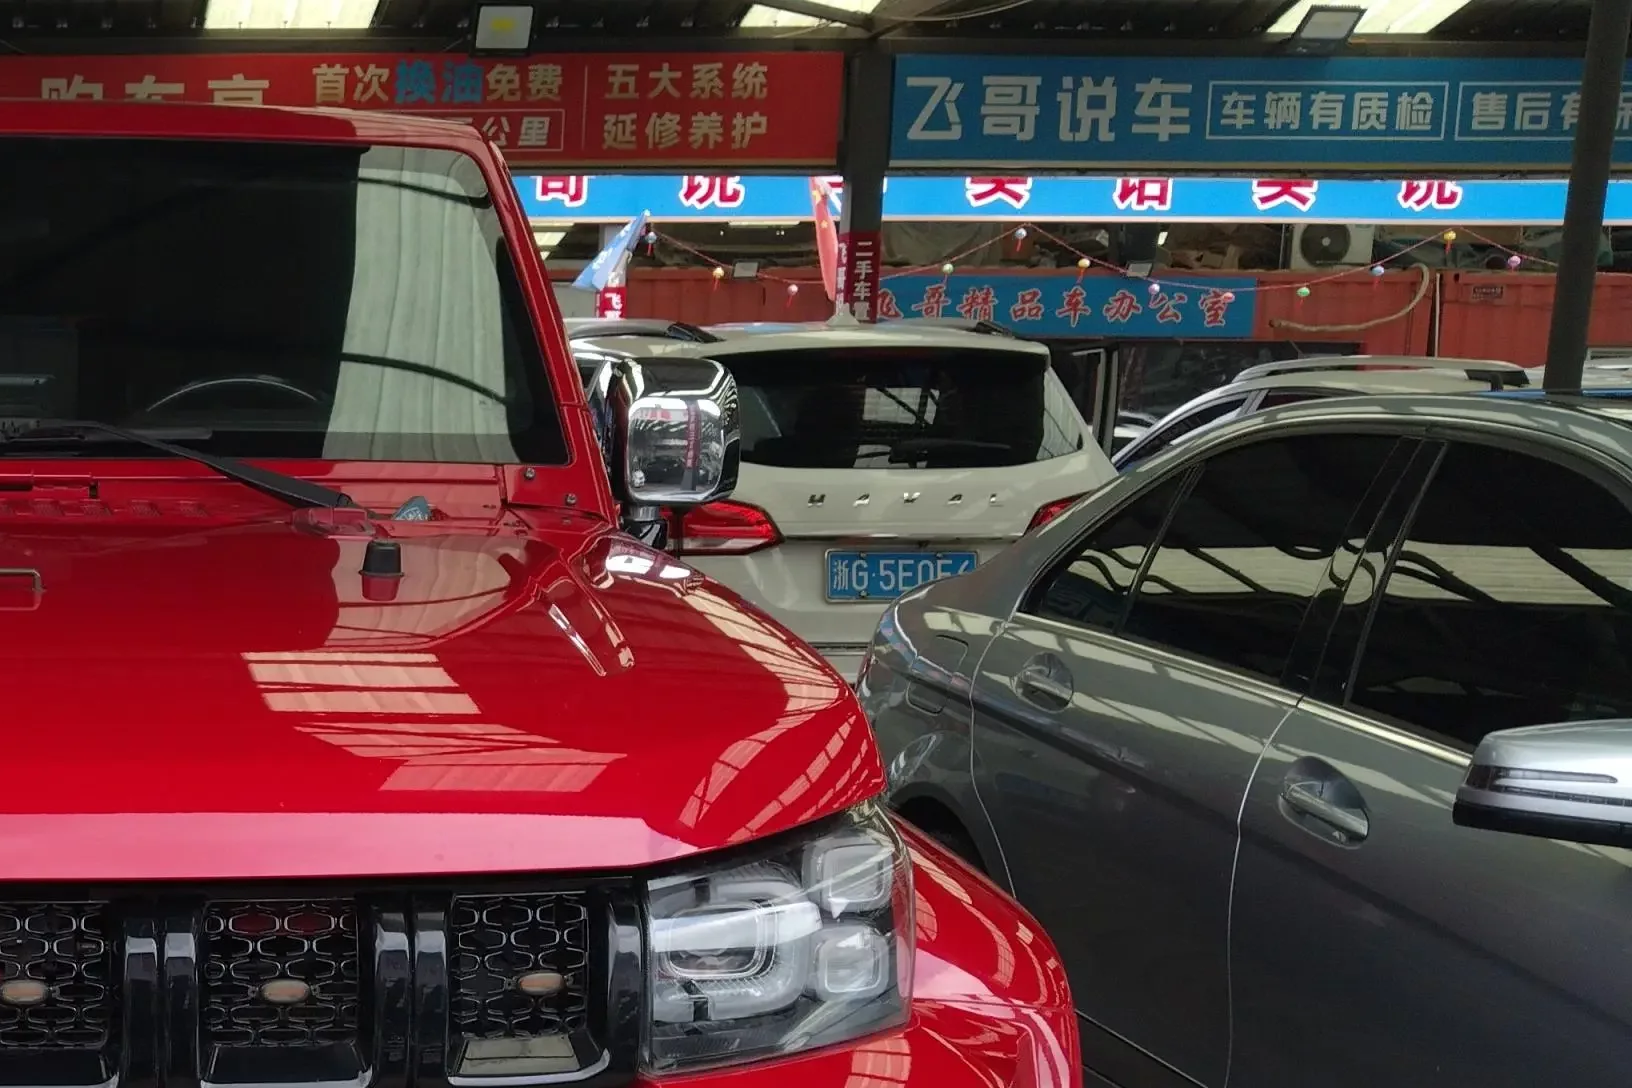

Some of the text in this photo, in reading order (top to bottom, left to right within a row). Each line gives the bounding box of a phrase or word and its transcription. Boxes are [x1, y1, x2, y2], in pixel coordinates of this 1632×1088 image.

[312, 58, 563, 105] 首次换油免费
[606, 62, 770, 100] 五大系统
[906, 76, 1194, 142] 飞哥说车
[1221, 91, 1435, 132] 车辆有质检
[603, 111, 769, 150] 延修养护
